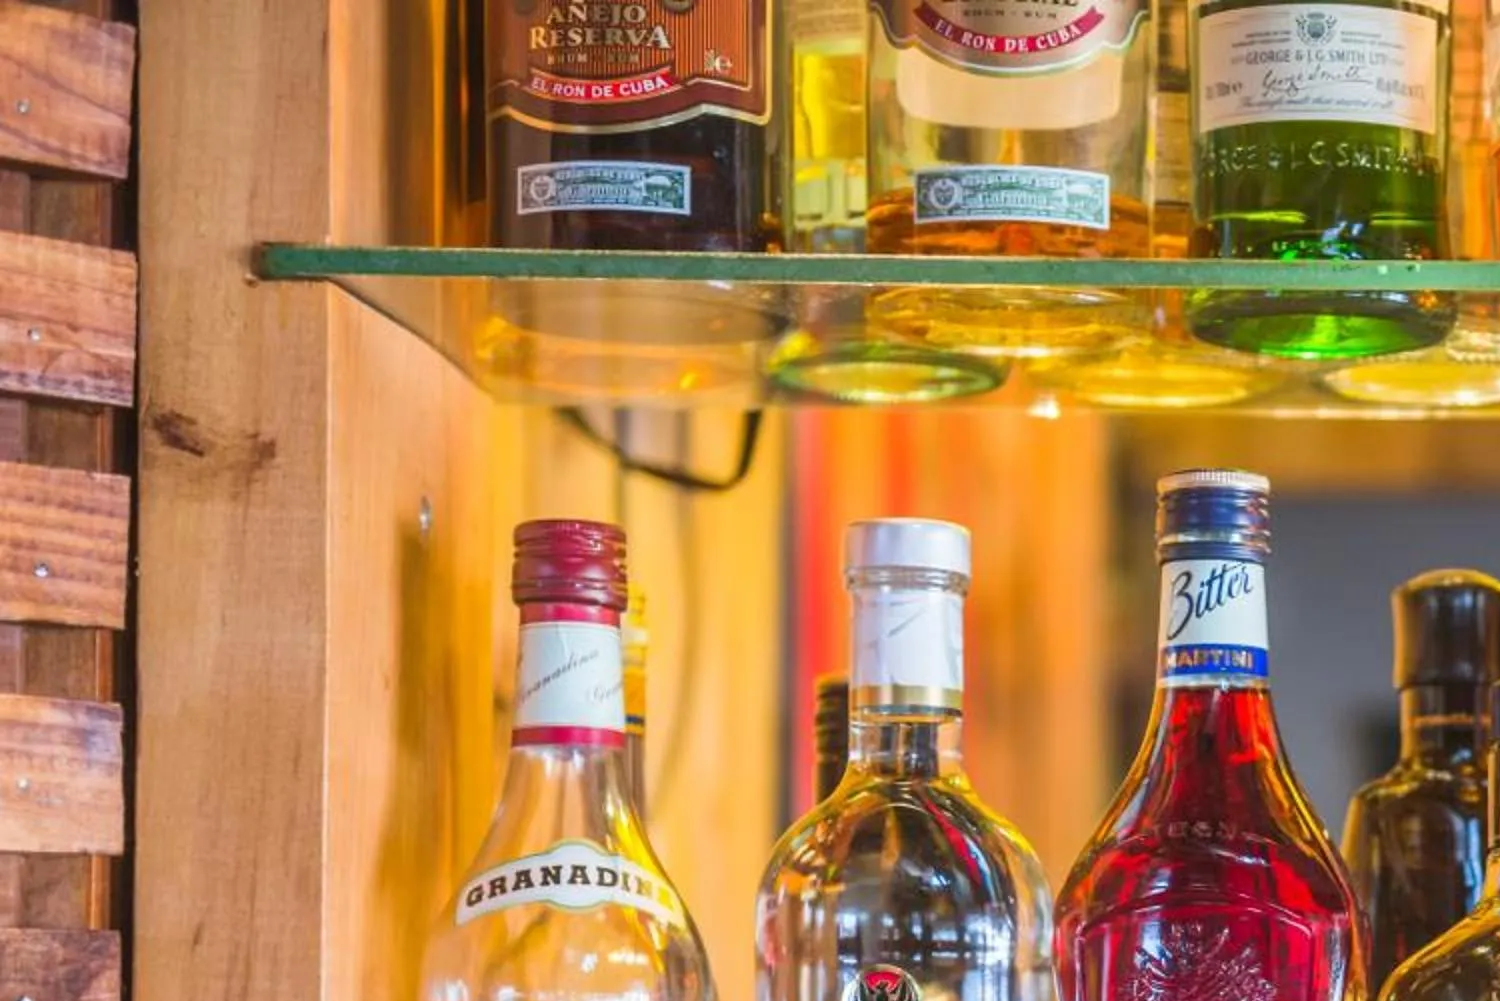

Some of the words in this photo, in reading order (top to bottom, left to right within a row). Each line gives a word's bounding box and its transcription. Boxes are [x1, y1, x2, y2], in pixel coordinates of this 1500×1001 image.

[529, 25, 672, 49] RESERVA
[935, 19, 953, 37] EL
[961, 31, 996, 50] RON
[1004, 39, 1029, 51] DE
[1036, 24, 1083, 49] CUBA
[1245, 49, 1291, 65] GEORGE
[1328, 49, 1366, 65] SMITH
[531, 77, 546, 91] EL
[552, 84, 585, 97] RON
[591, 85, 614, 98] DE
[619, 76, 669, 96] CUBA
[1166, 561, 1254, 641] Bitter
[1165, 648, 1254, 669] MARTINI
